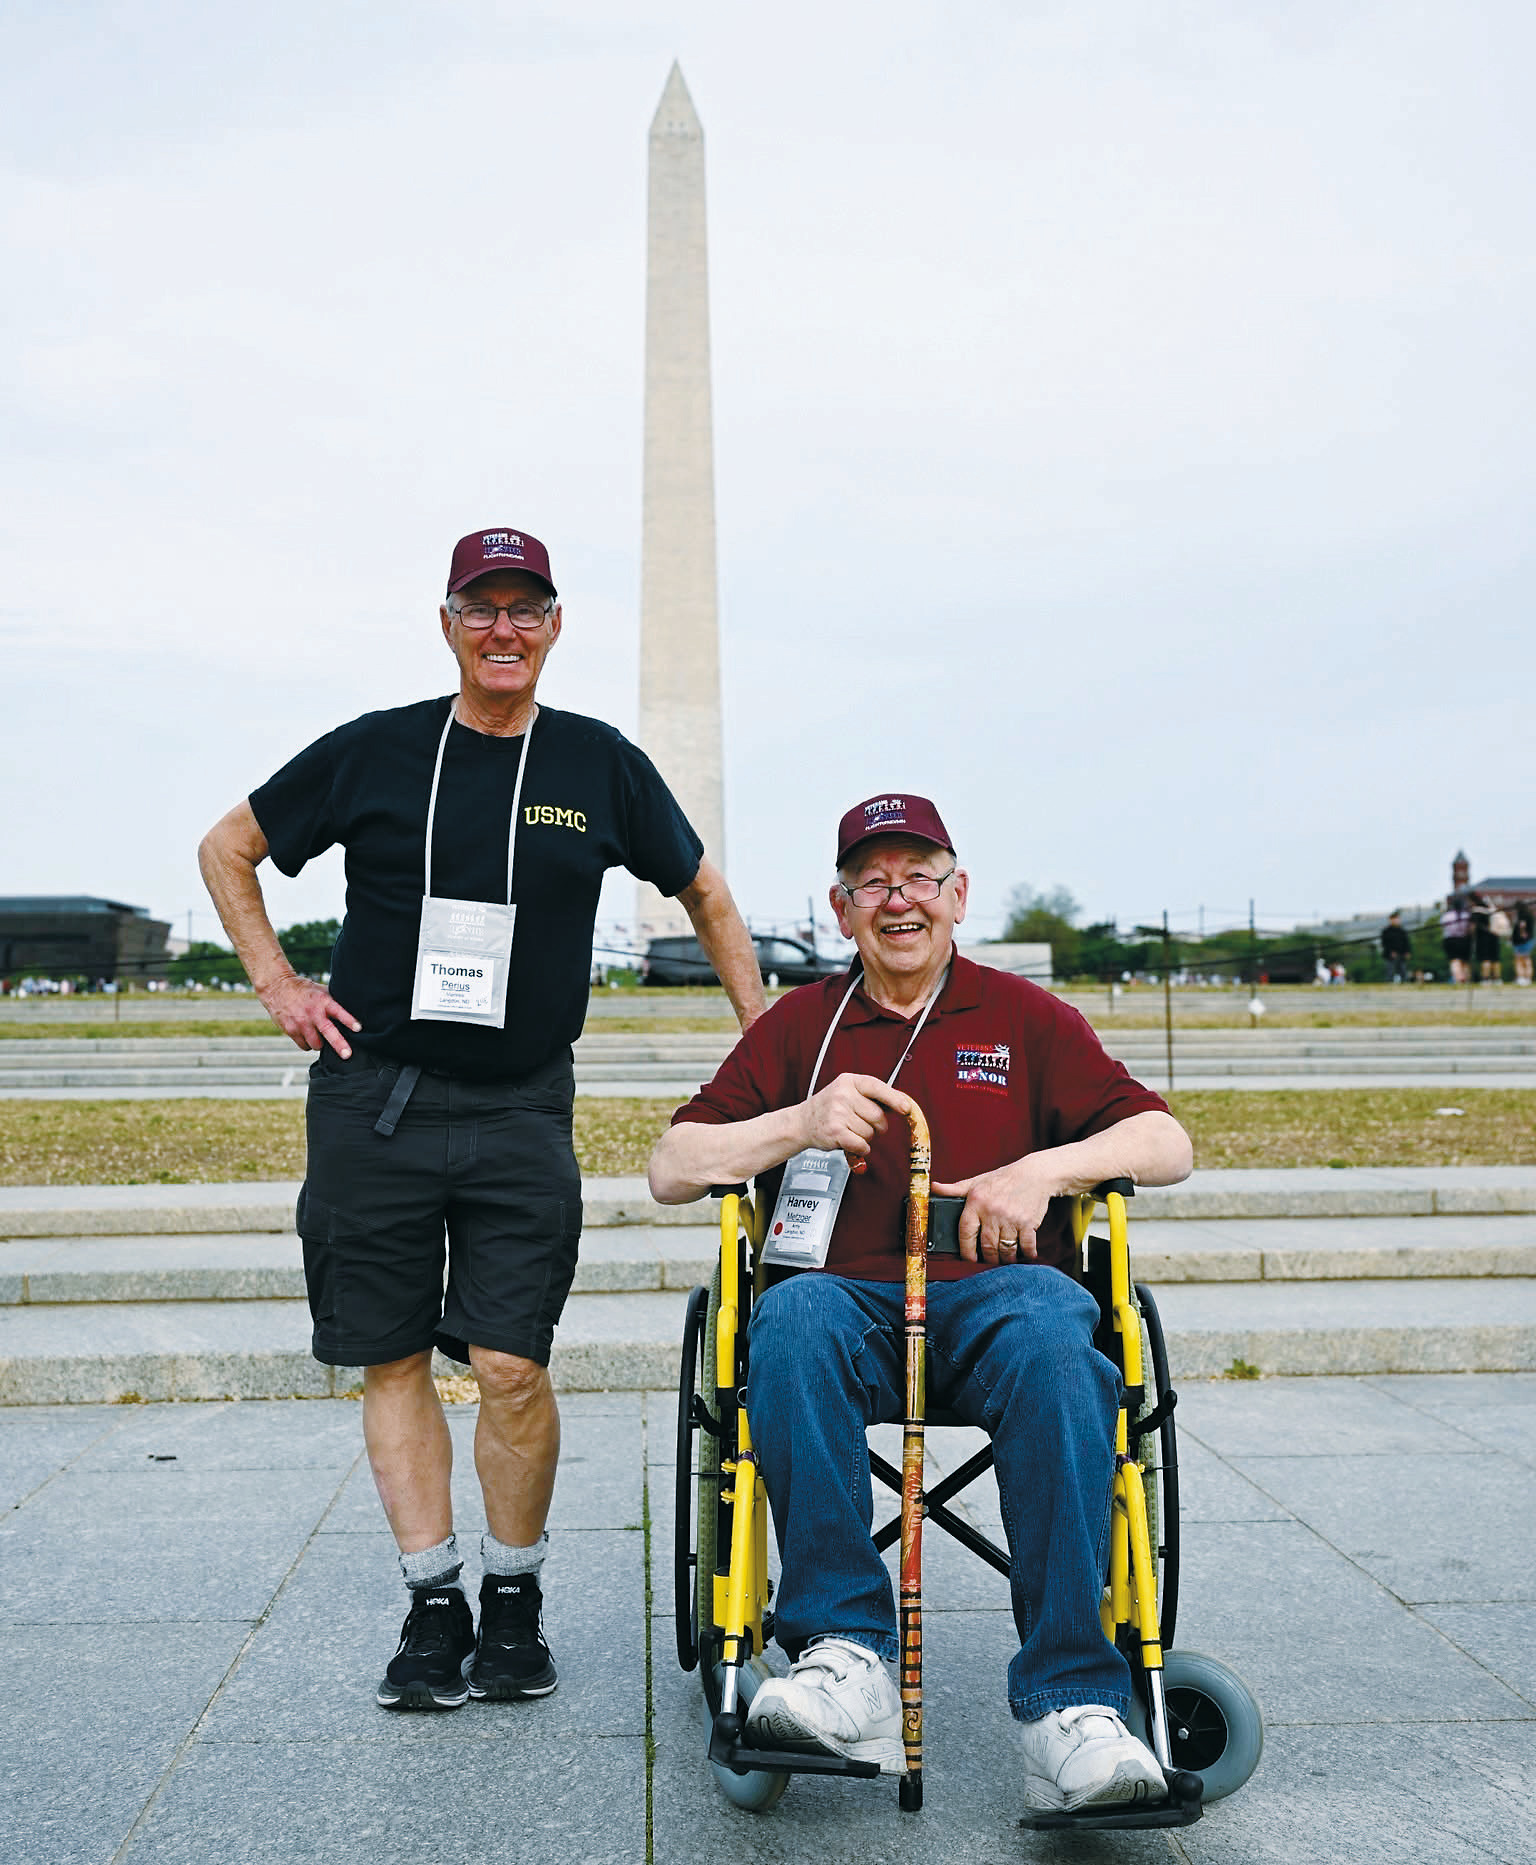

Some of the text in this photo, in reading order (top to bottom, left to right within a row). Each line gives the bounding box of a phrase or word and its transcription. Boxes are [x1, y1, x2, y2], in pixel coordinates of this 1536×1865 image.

[524, 805, 587, 833] USMC
[431, 963, 483, 978] Thomas
[957, 1043, 994, 1051] VETERANS
[787, 1196, 820, 1211] Harvey
[497, 1586, 520, 1594] HOKA
[426, 1597, 449, 1606] HOKA
